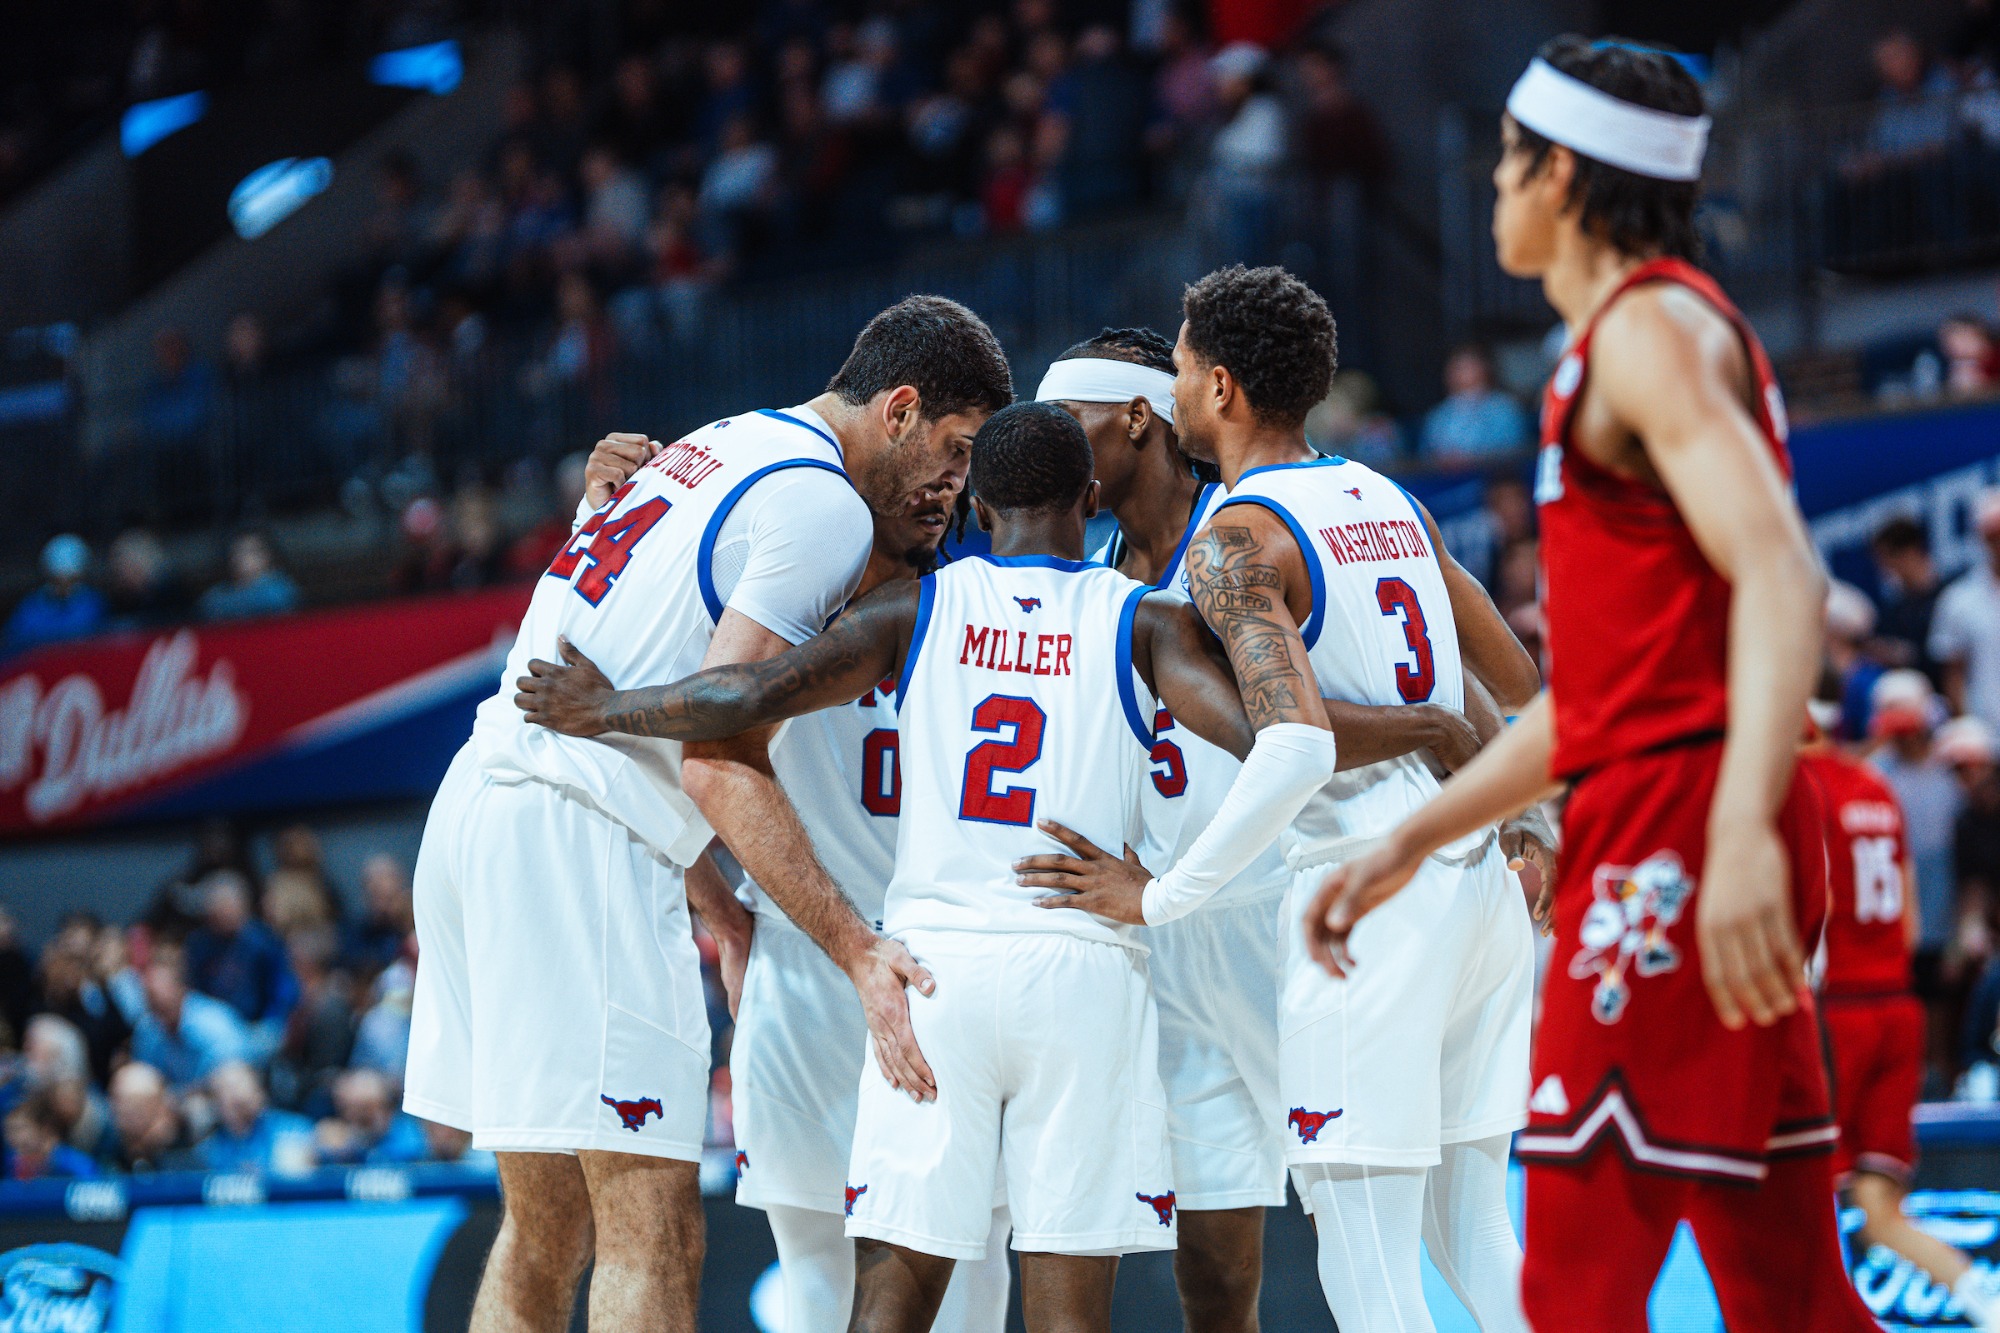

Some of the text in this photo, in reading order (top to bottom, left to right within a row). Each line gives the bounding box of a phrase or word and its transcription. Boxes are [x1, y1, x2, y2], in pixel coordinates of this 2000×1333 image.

[546, 481, 673, 609] 24
[1319, 520, 1429, 566] WASHINGTON
[960, 623, 1073, 676] MILLER
[1375, 577, 1436, 704] 3
[861, 727, 902, 818] 0
[958, 693, 1047, 828] 2
[1150, 708, 1188, 799] 5
